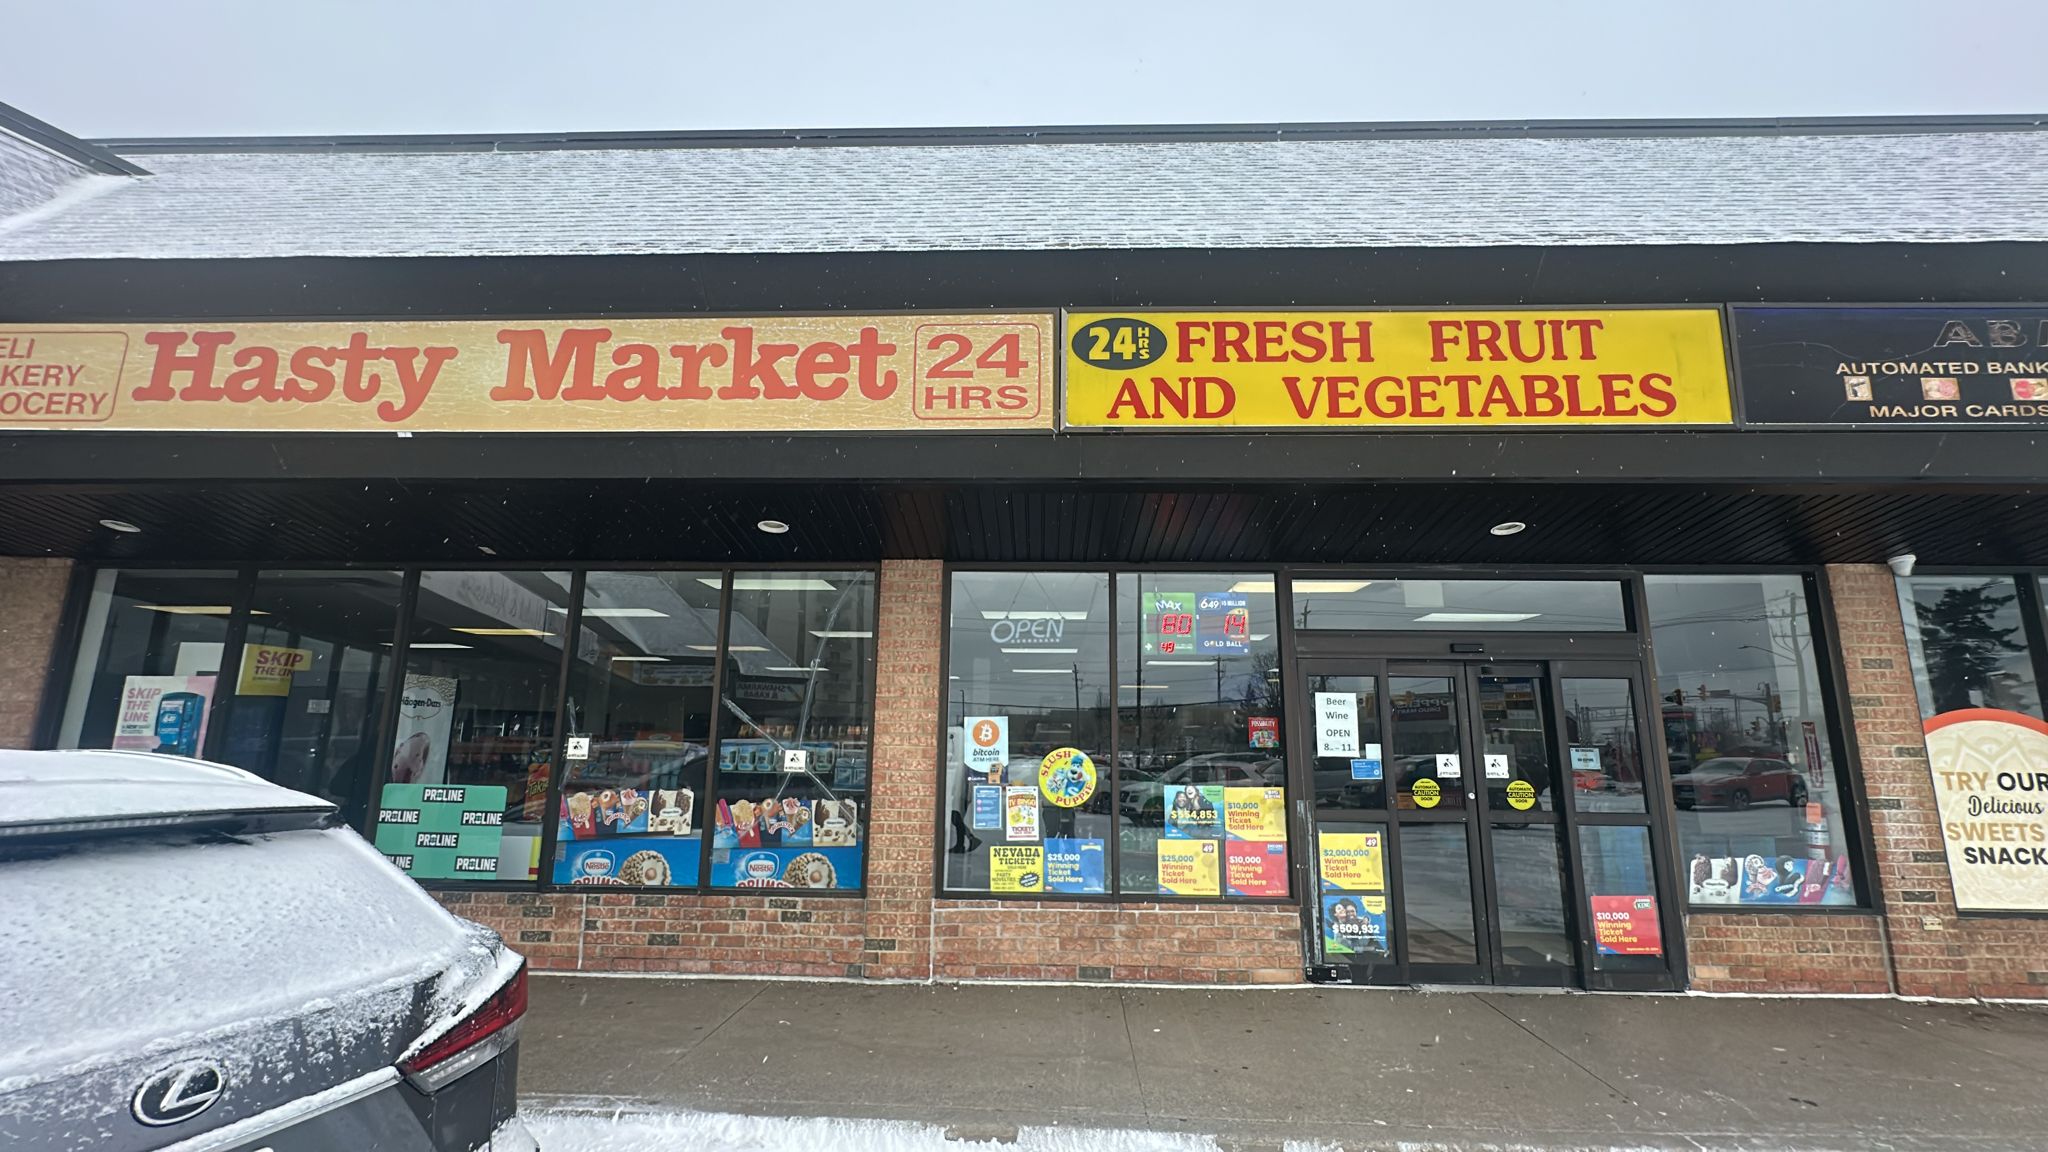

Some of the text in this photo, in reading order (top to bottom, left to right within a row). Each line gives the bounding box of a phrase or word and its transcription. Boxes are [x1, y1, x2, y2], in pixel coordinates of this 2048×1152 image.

[1089, 326, 1150, 360] 24 HRS
[1176, 319, 1604, 363] FRESH FRUIT
[925, 333, 1029, 379] 24
[131, 326, 898, 422] Hasty Market
[1837, 362, 1980, 374] AUTOMATED
[924, 386, 1029, 410] HRS
[1106, 374, 1677, 419] AND VEGETABLES
[1869, 405, 2048, 417] MAJOR CARDS
[1155, 599, 1182, 612] MAX
[1161, 613, 1193, 635] 80
[1223, 614, 1246, 635] 14
[990, 617, 1065, 644] OPEN
[257, 650, 304, 667] SKIP
[255, 666, 276, 676] THE
[127, 688, 162, 700] SKIP
[126, 700, 151, 711] THE
[1326, 698, 1346, 706] Beer
[123, 711, 150, 722] LINE
[1325, 711, 1349, 720] Wine
[1326, 729, 1351, 737] OPEN
[973, 748, 1000, 756] bitcoin
[1041, 751, 1071, 777] SLUSH
[1940, 772, 2048, 791] TRY OUR
[424, 788, 464, 801] PROLINE
[1968, 795, 2045, 816] Delicious
[378, 810, 419, 822] PROLINE
[462, 812, 503, 825] PROLINE
[1228, 810, 1260, 818] Winning
[1946, 822, 2045, 842] SWEETS
[417, 833, 458, 846] PROLINE
[993, 848, 1040, 857] NEVADA
[1048, 853, 1080, 862] $25,000
[1323, 849, 1369, 857] $2,000,000
[1964, 847, 2048, 865] SNACK
[456, 858, 497, 870] PROLINE
[1161, 855, 1194, 863] $25,000
[1229, 856, 1261, 864] $10,000
[1324, 858, 1356, 866] Winning
[1048, 863, 1080, 871] Winning
[1162, 863, 1193, 872] Winning
[1230, 864, 1262, 873] Winning
[1596, 912, 1629, 920] $10,000
[1332, 924, 1380, 935] $509,932
[1598, 921, 1631, 930] Winning
